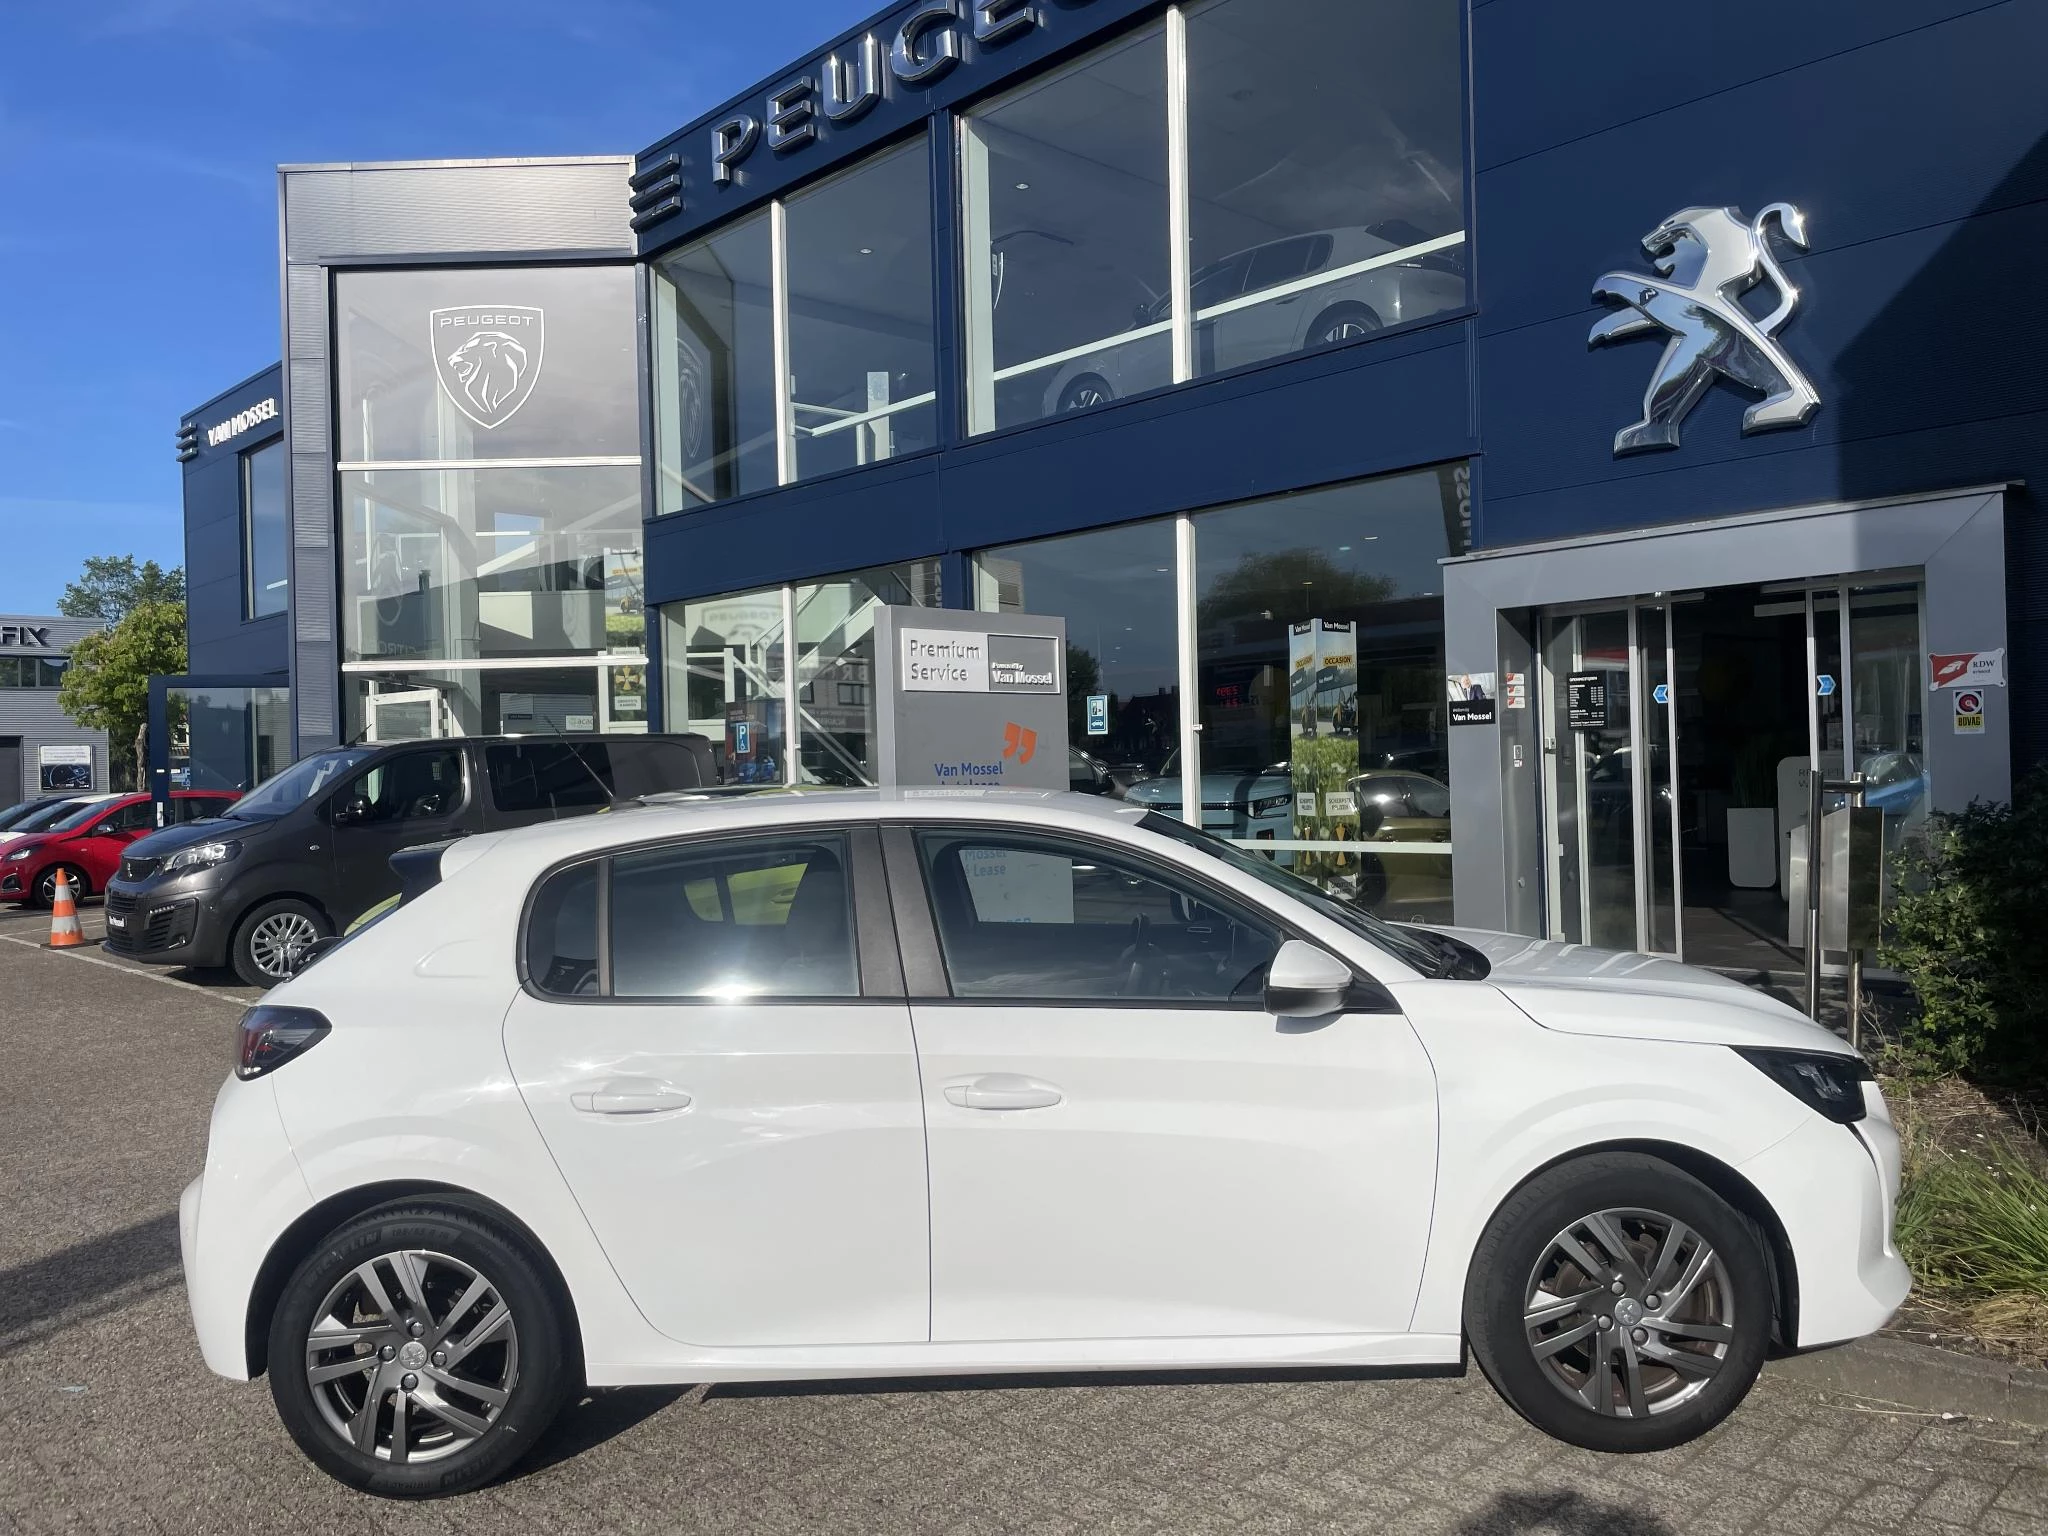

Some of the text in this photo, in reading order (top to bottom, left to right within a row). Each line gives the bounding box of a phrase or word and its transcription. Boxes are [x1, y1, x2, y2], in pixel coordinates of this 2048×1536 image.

[440, 315, 534, 328] PEUGEOT
[208, 398, 279, 447] VAN MOSSEL
[1324, 621, 1350, 630] Van Mossel
[910, 639, 981, 660] Premium
[1324, 656, 1351, 665] OCCASION
[1973, 660, 1995, 668] RDW
[911, 662, 969, 681] Service
[992, 670, 1053, 685] Van Mossel
[1453, 711, 1492, 721] Van Mossel
[1958, 716, 1981, 727] BOVAG
[740, 725, 747, 740] P
[935, 761, 1004, 776] Van Mossel
[973, 864, 1007, 877] Lease
